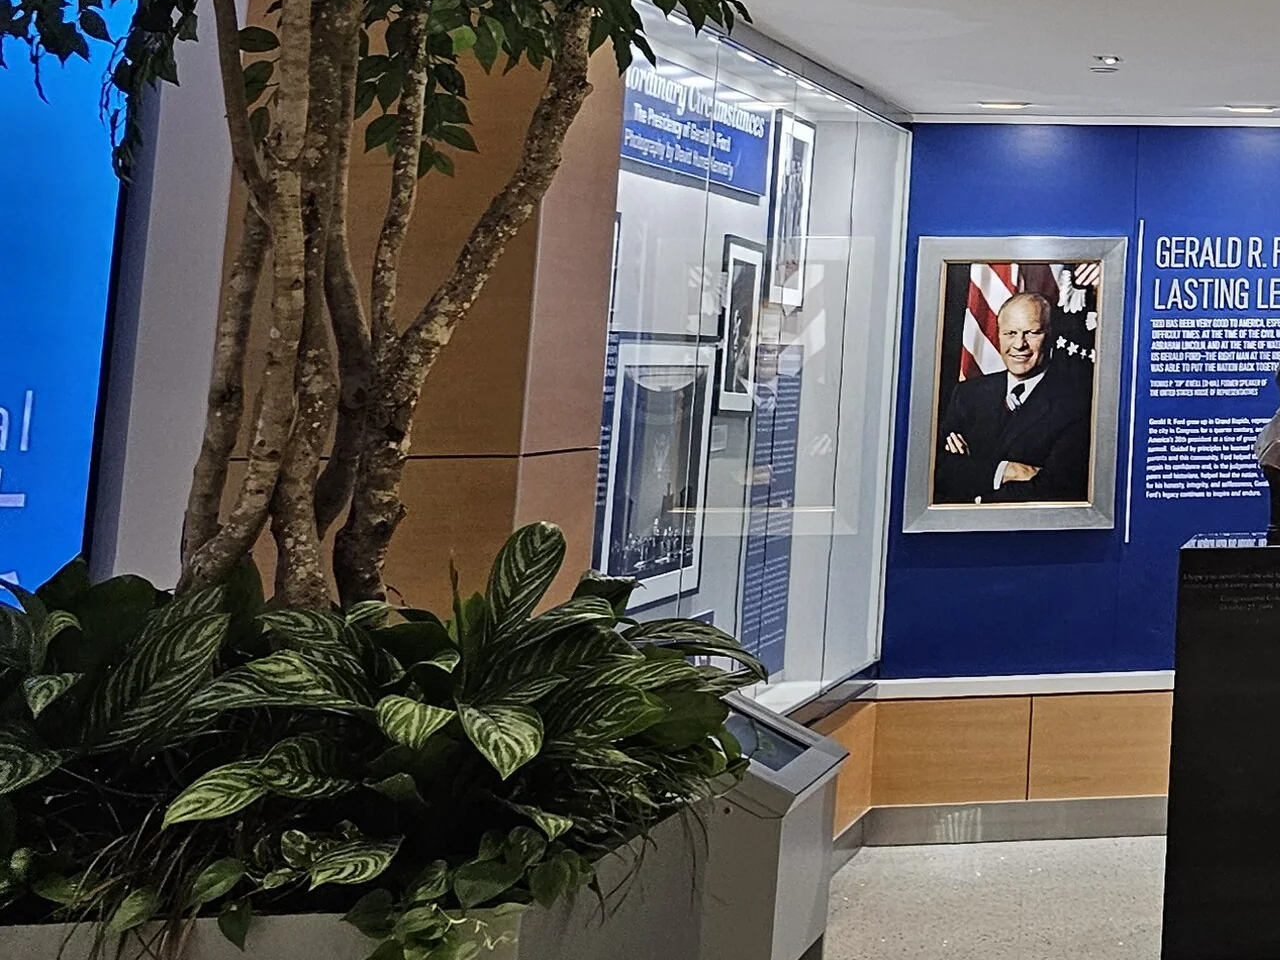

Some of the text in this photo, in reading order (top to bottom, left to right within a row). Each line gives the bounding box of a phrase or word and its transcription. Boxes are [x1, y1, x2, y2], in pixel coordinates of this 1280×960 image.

[1156, 236, 1242, 268] GERALD
[1248, 236, 1267, 268] R.
[1154, 278, 1249, 310] LASTING
